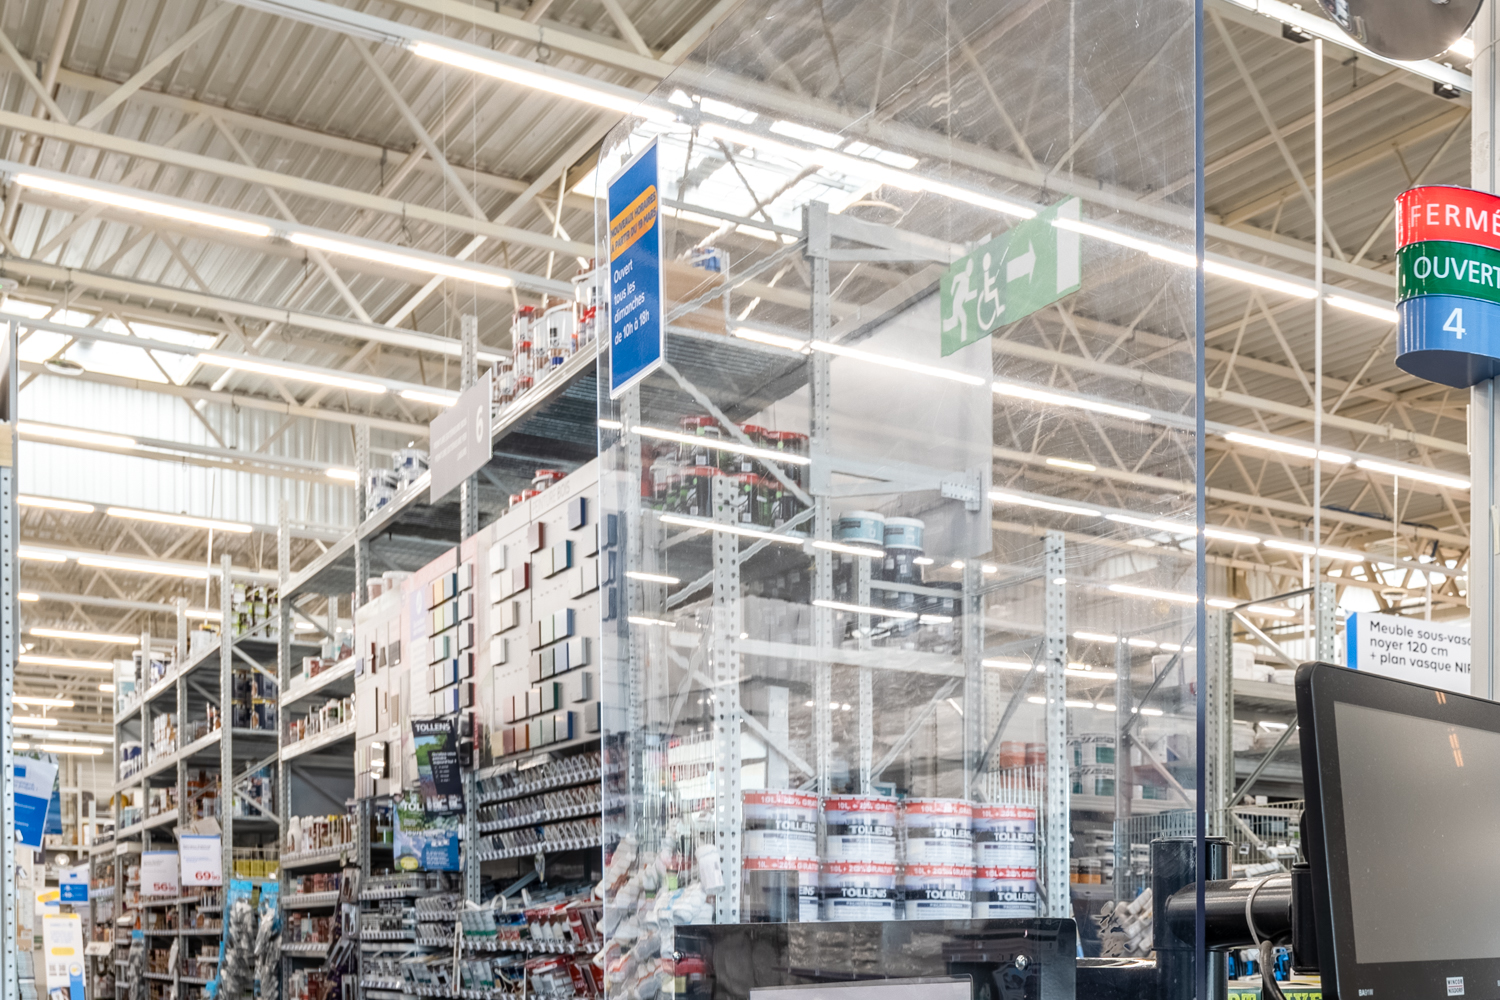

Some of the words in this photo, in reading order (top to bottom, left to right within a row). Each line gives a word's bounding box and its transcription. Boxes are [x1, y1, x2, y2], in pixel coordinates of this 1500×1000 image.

[613, 258, 633, 284] Ouvert
[614, 288, 626, 306] tous
[627, 280, 636, 296] les
[614, 291, 646, 324] dimanches
[614, 331, 622, 346] de
[623, 322, 634, 339] 10h
[634, 317, 639, 331] à
[639, 309, 650, 327] 18h
[1443, 307, 1465, 340] 4
[475, 404, 484, 443] 6
[1369, 620, 1414, 638] Meuble
[1369, 638, 1404, 652] noyer
[1407, 641, 1428, 654] 120
[1430, 646, 1448, 657] cm
[1380, 653, 1406, 666] plan
[1409, 657, 1451, 673] vasque
[415, 722, 451, 733] TOLLENS
[775, 819, 816, 833] TOLLENS
[849, 824, 893, 836] TOLLENS
[994, 832, 1034, 842] TOLLENS
[842, 888, 887, 898] TOLLENS
[925, 889, 966, 900] TOLLENS
[997, 892, 1036, 902] TOLLENS
